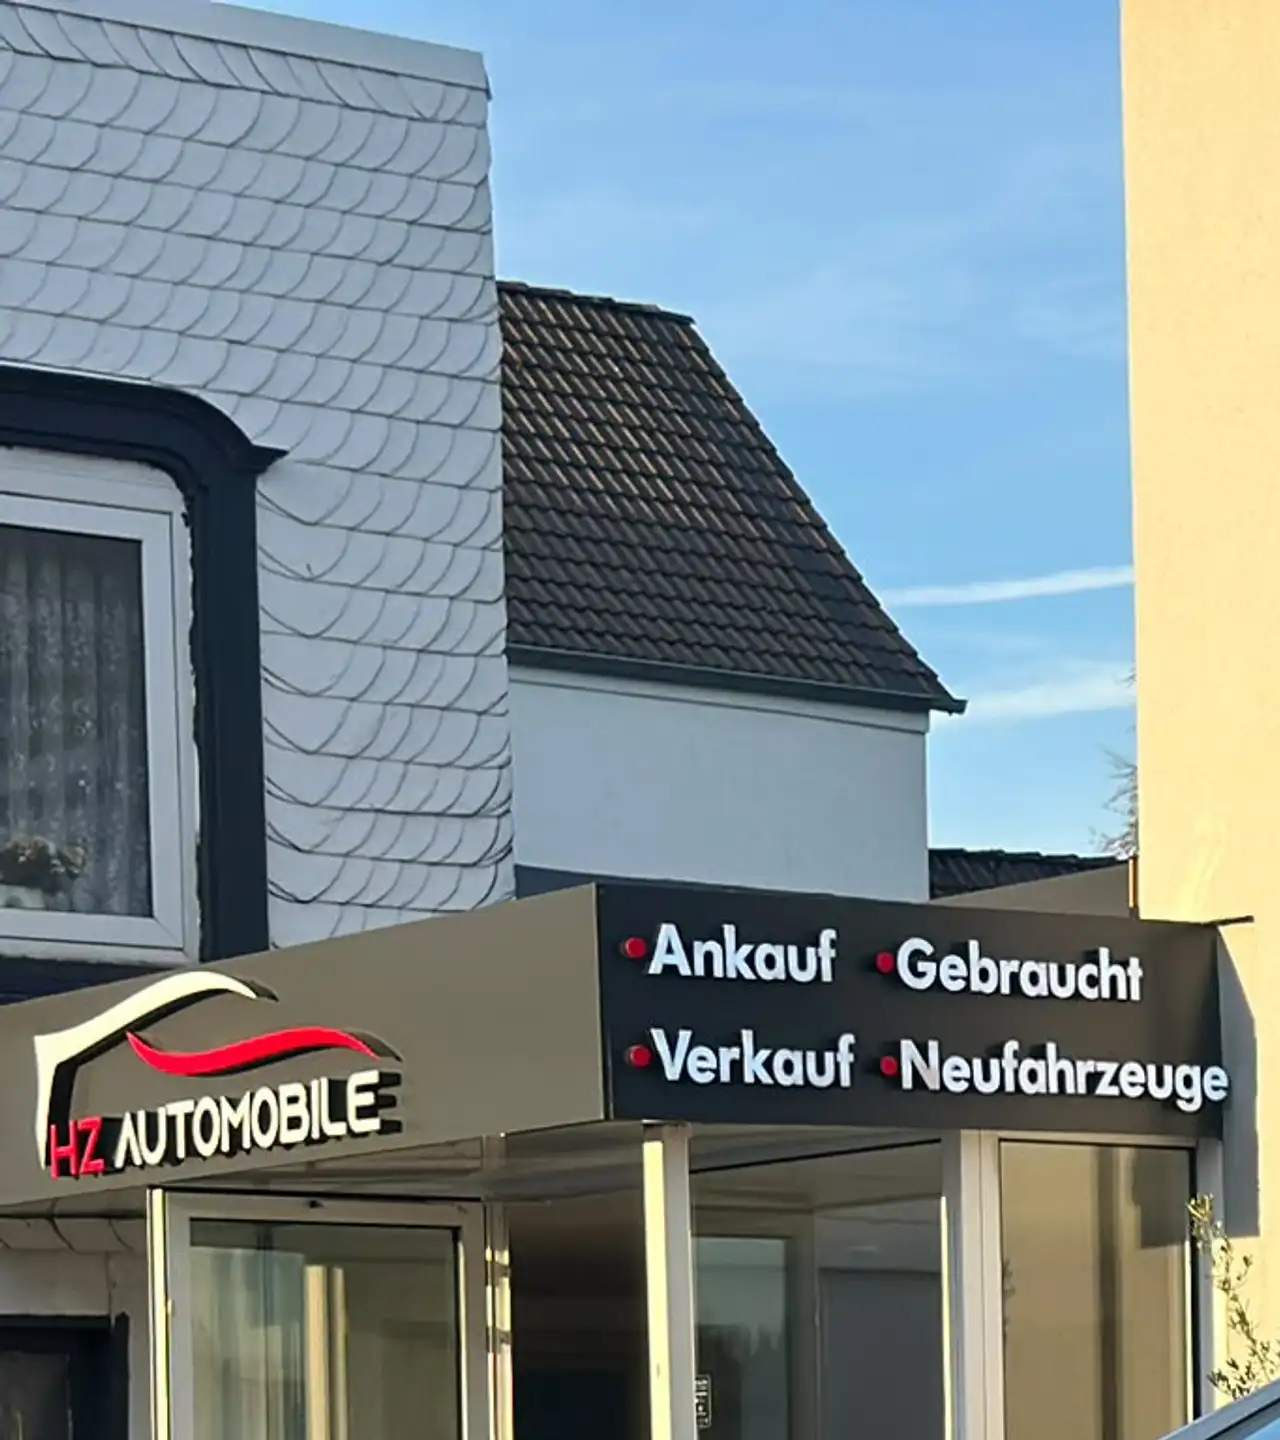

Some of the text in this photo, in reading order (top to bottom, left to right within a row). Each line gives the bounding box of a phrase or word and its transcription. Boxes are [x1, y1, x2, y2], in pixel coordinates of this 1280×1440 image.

[648, 922, 1144, 1001] Ankauf Gebraucht
[650, 1028, 1230, 1112] Verkauf Neufahrzeuge
[49, 1069, 381, 1179] HZ AUTOMOBILE
